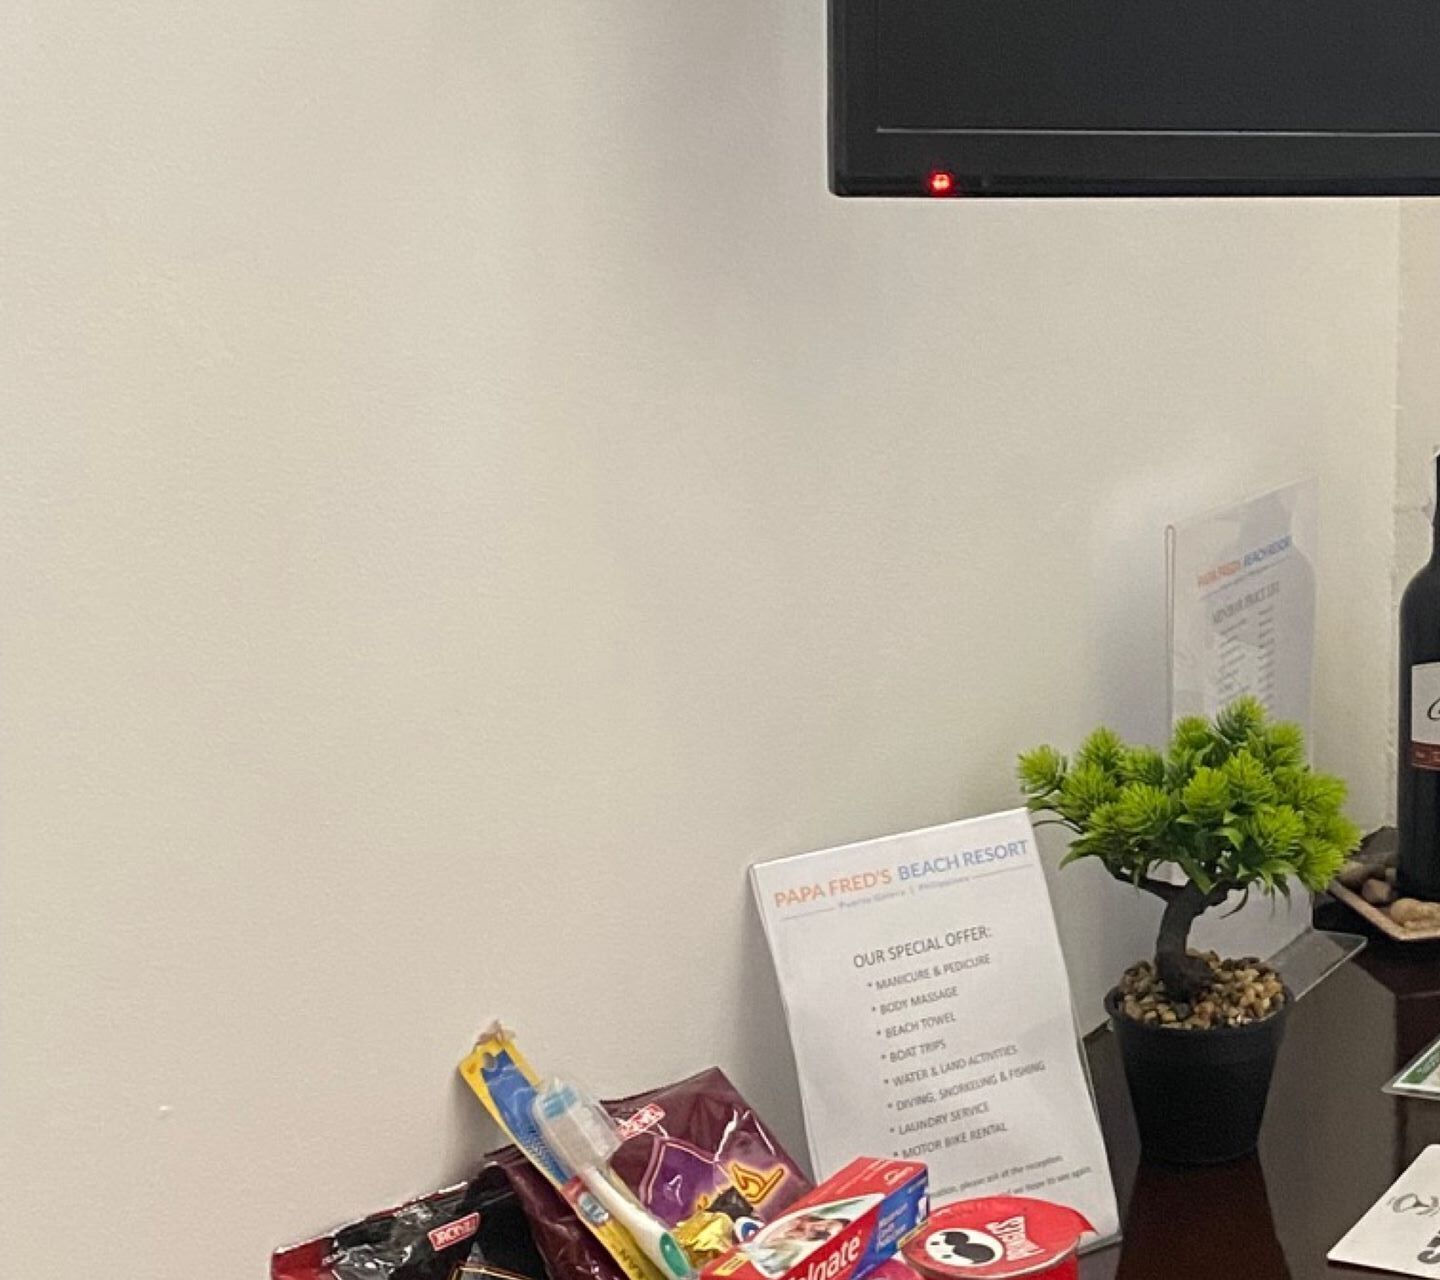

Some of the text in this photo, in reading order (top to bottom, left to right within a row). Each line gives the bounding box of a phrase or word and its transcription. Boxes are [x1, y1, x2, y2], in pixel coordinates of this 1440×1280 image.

[774, 840, 1028, 908] PAPA FRED'S BEACH RESORT
[853, 926, 993, 969] OUR SPECIAL OFFER:
[876, 968, 931, 991] MANICURE
[943, 954, 991, 974] PEDICURE
[880, 986, 959, 1016] BODY MASSAGE
[885, 1012, 956, 1039] BEACH TOWEL
[890, 1039, 946, 1063] BOAT TRIPS
[892, 1069, 929, 1087] WATER
[941, 1057, 967, 1074] LAND
[968, 1044, 1018, 1066] ACTIVITIES
[939, 1073, 998, 1099] SNORKELING
[1009, 1060, 1046, 1080] FISHING
[899, 1101, 990, 1135] LAUNDRY SERVICE
[902, 1122, 1008, 1159] MOTOR BIKE RENTAL
